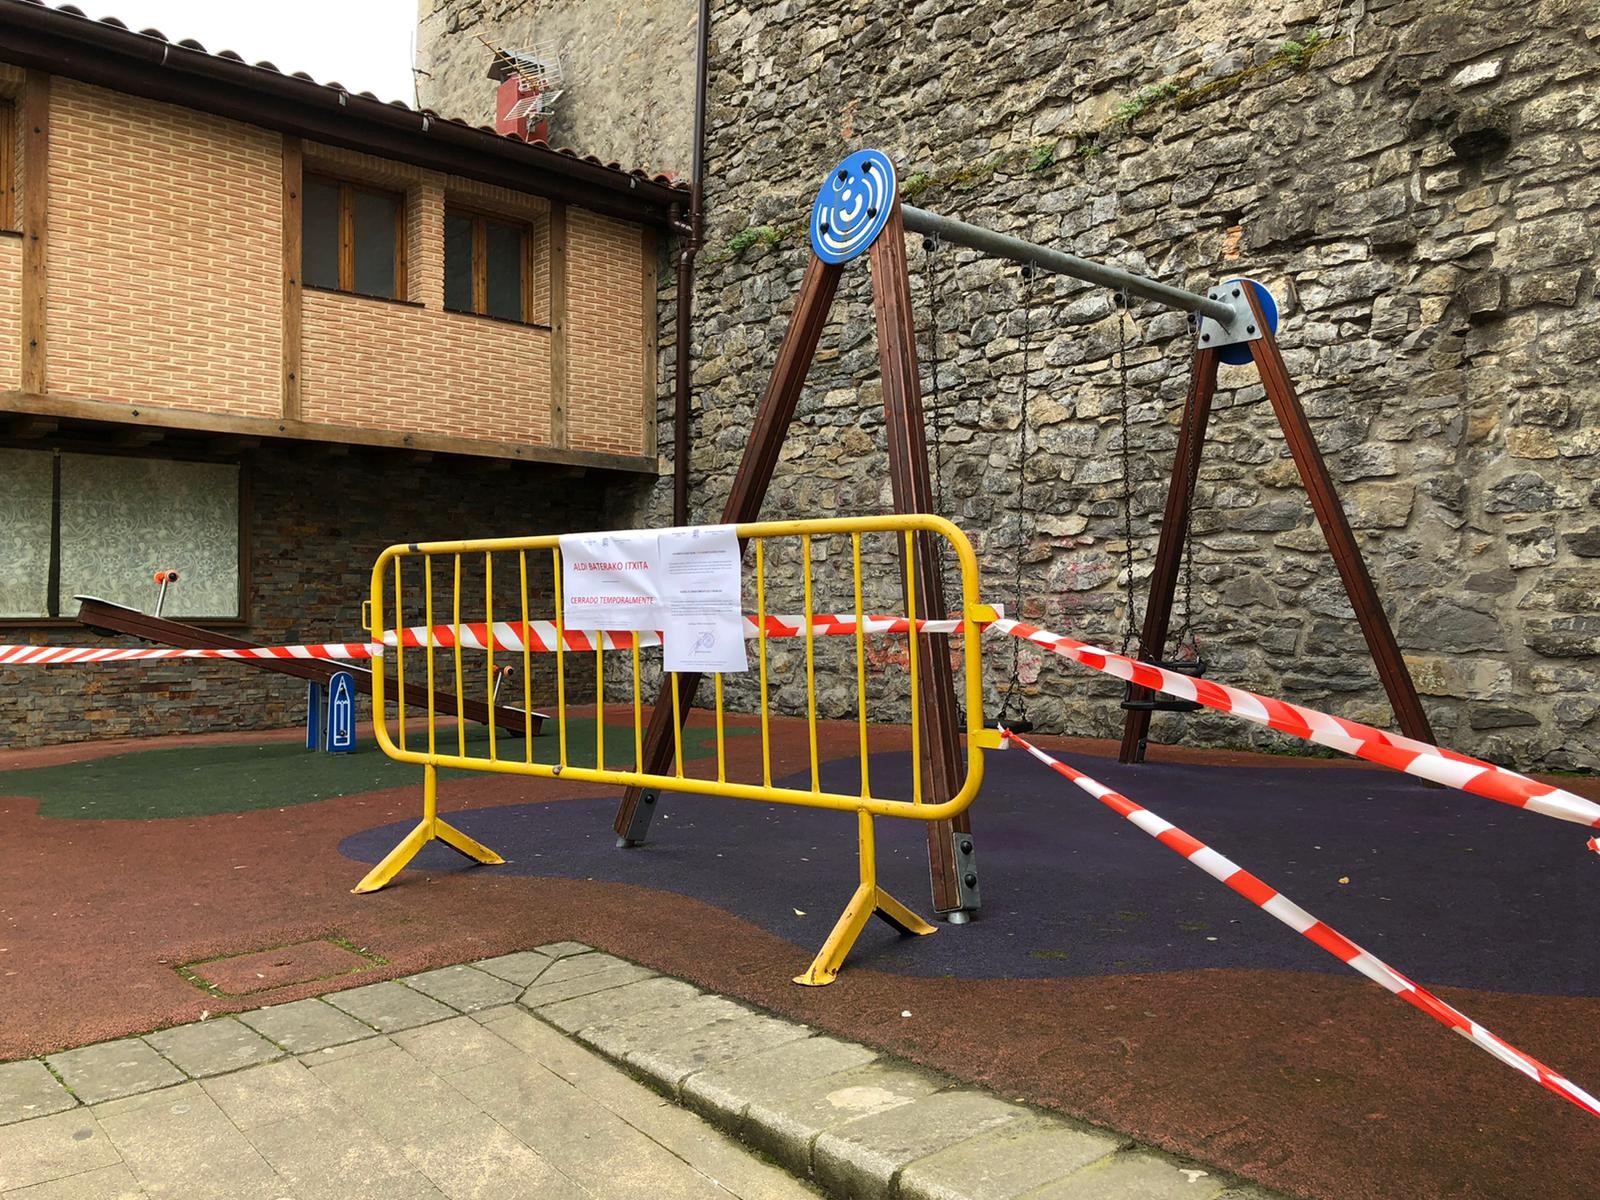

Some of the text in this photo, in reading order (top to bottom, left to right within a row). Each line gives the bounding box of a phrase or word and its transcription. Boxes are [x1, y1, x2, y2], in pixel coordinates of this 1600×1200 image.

[573, 561, 649, 571] ALDI BATERAKO ITXITA
[570, 596, 654, 604] CERRADO TEMPORALMENTE
